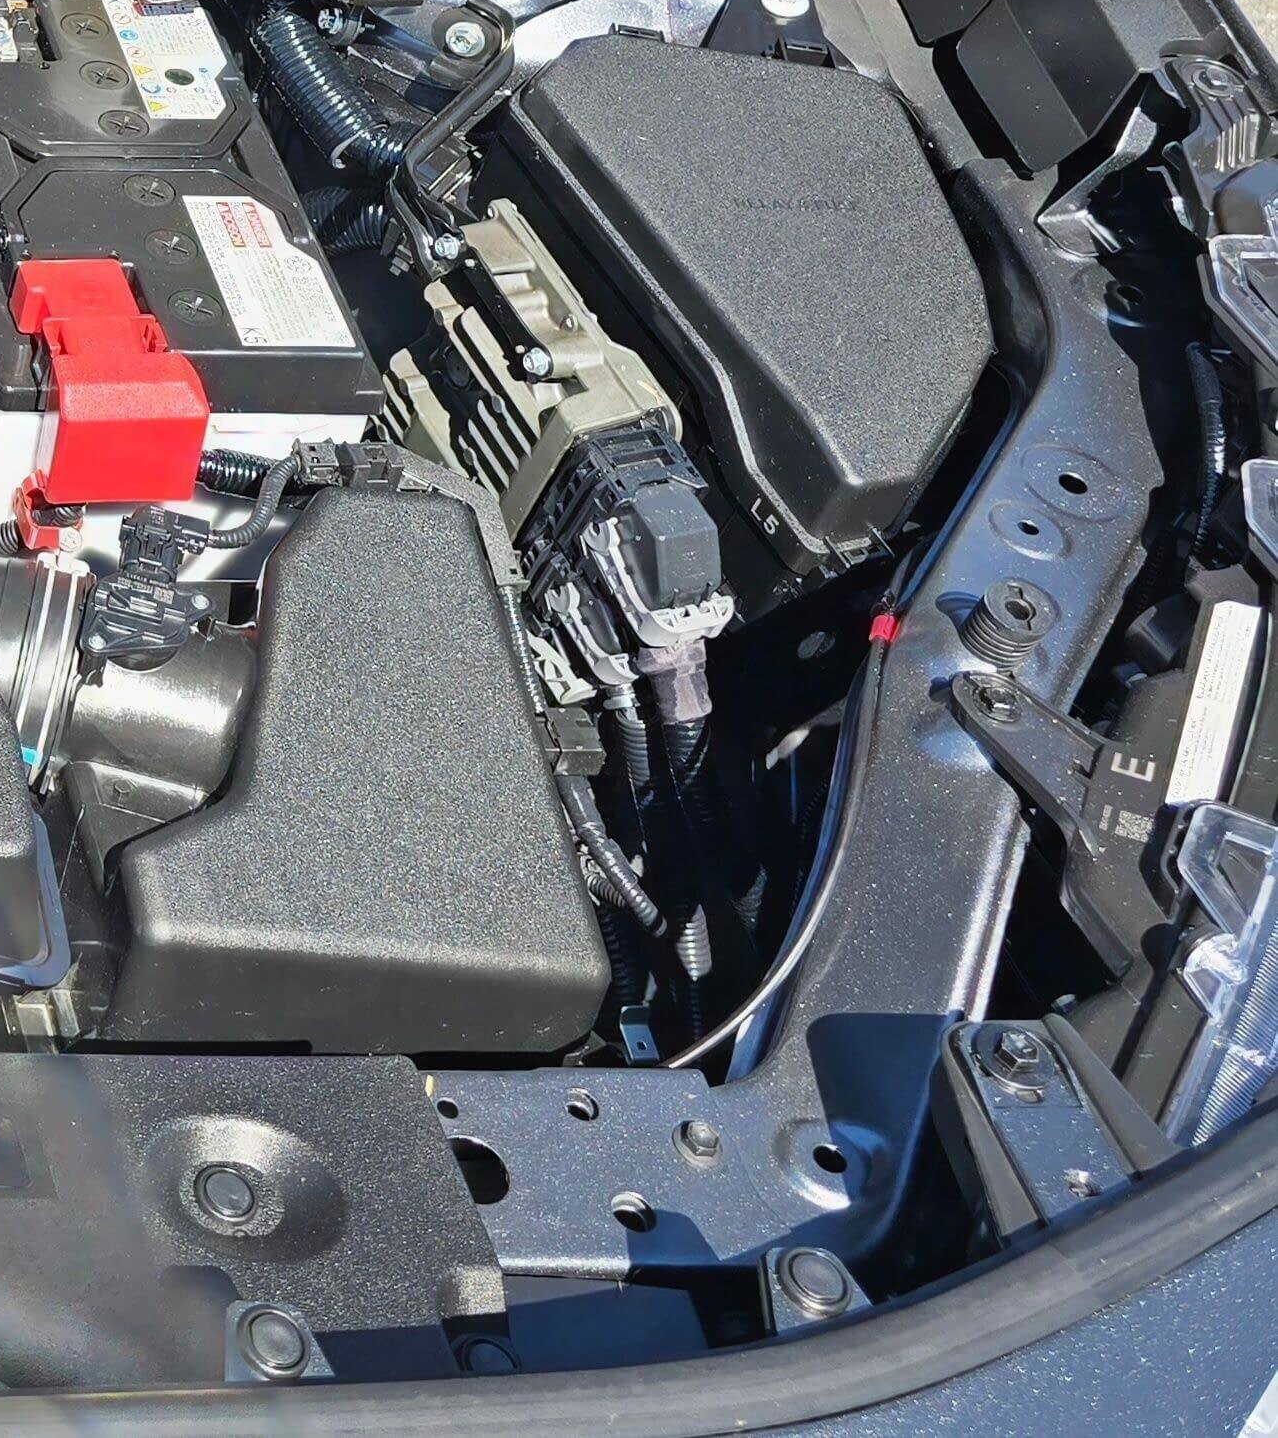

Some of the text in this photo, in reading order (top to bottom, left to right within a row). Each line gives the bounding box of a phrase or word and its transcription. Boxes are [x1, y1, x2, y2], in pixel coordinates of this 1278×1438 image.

[242, 327, 269, 345] K5
[750, 497, 780, 535] L5
[1111, 751, 1155, 783] E
